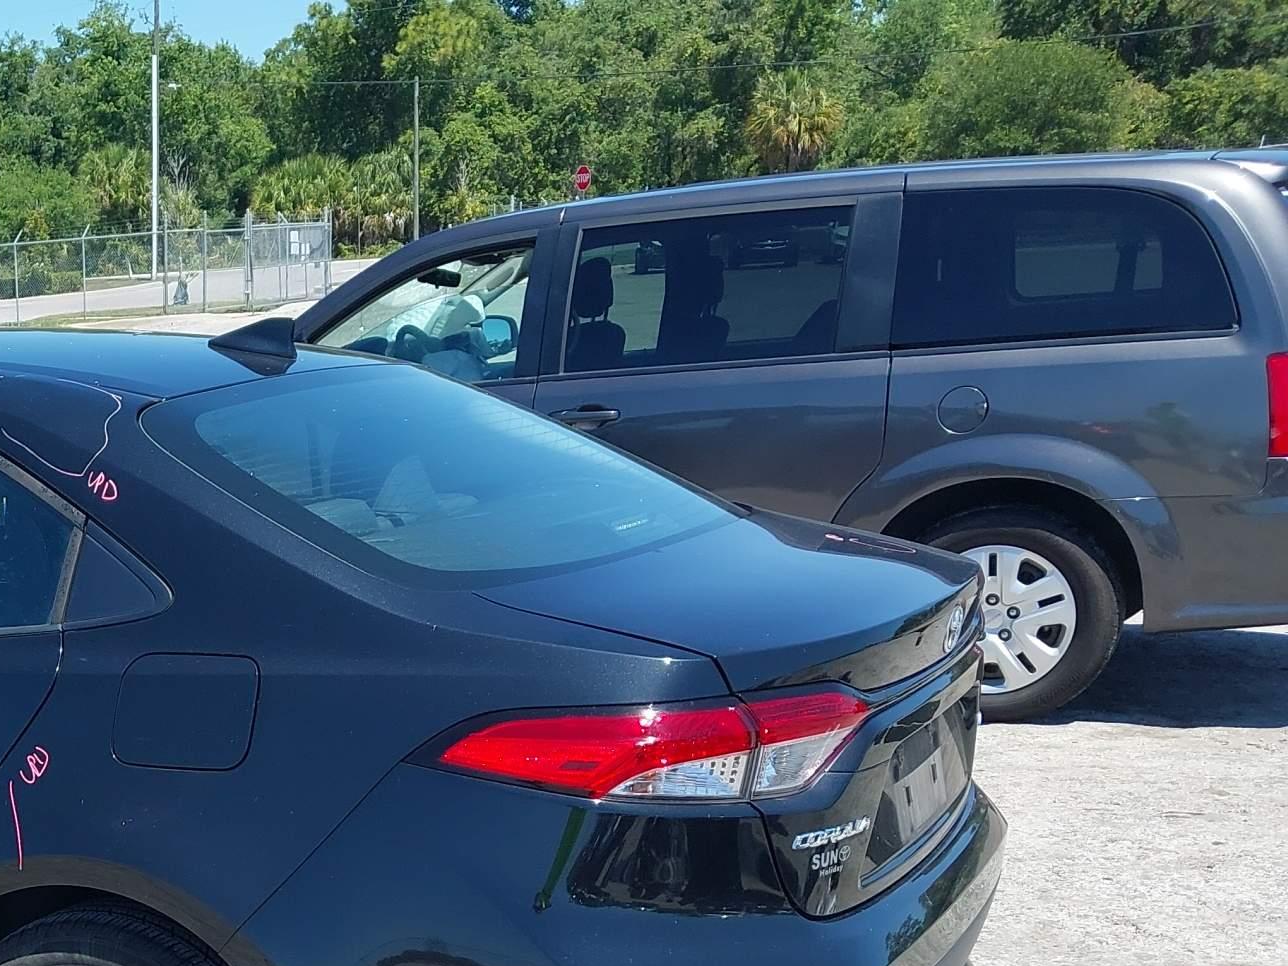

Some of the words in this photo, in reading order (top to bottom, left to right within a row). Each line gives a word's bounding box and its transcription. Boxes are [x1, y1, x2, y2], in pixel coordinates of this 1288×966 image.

[576, 173, 590, 184] STOP
[811, 849, 839, 870] SUN
[819, 864, 844, 877] Holiday
